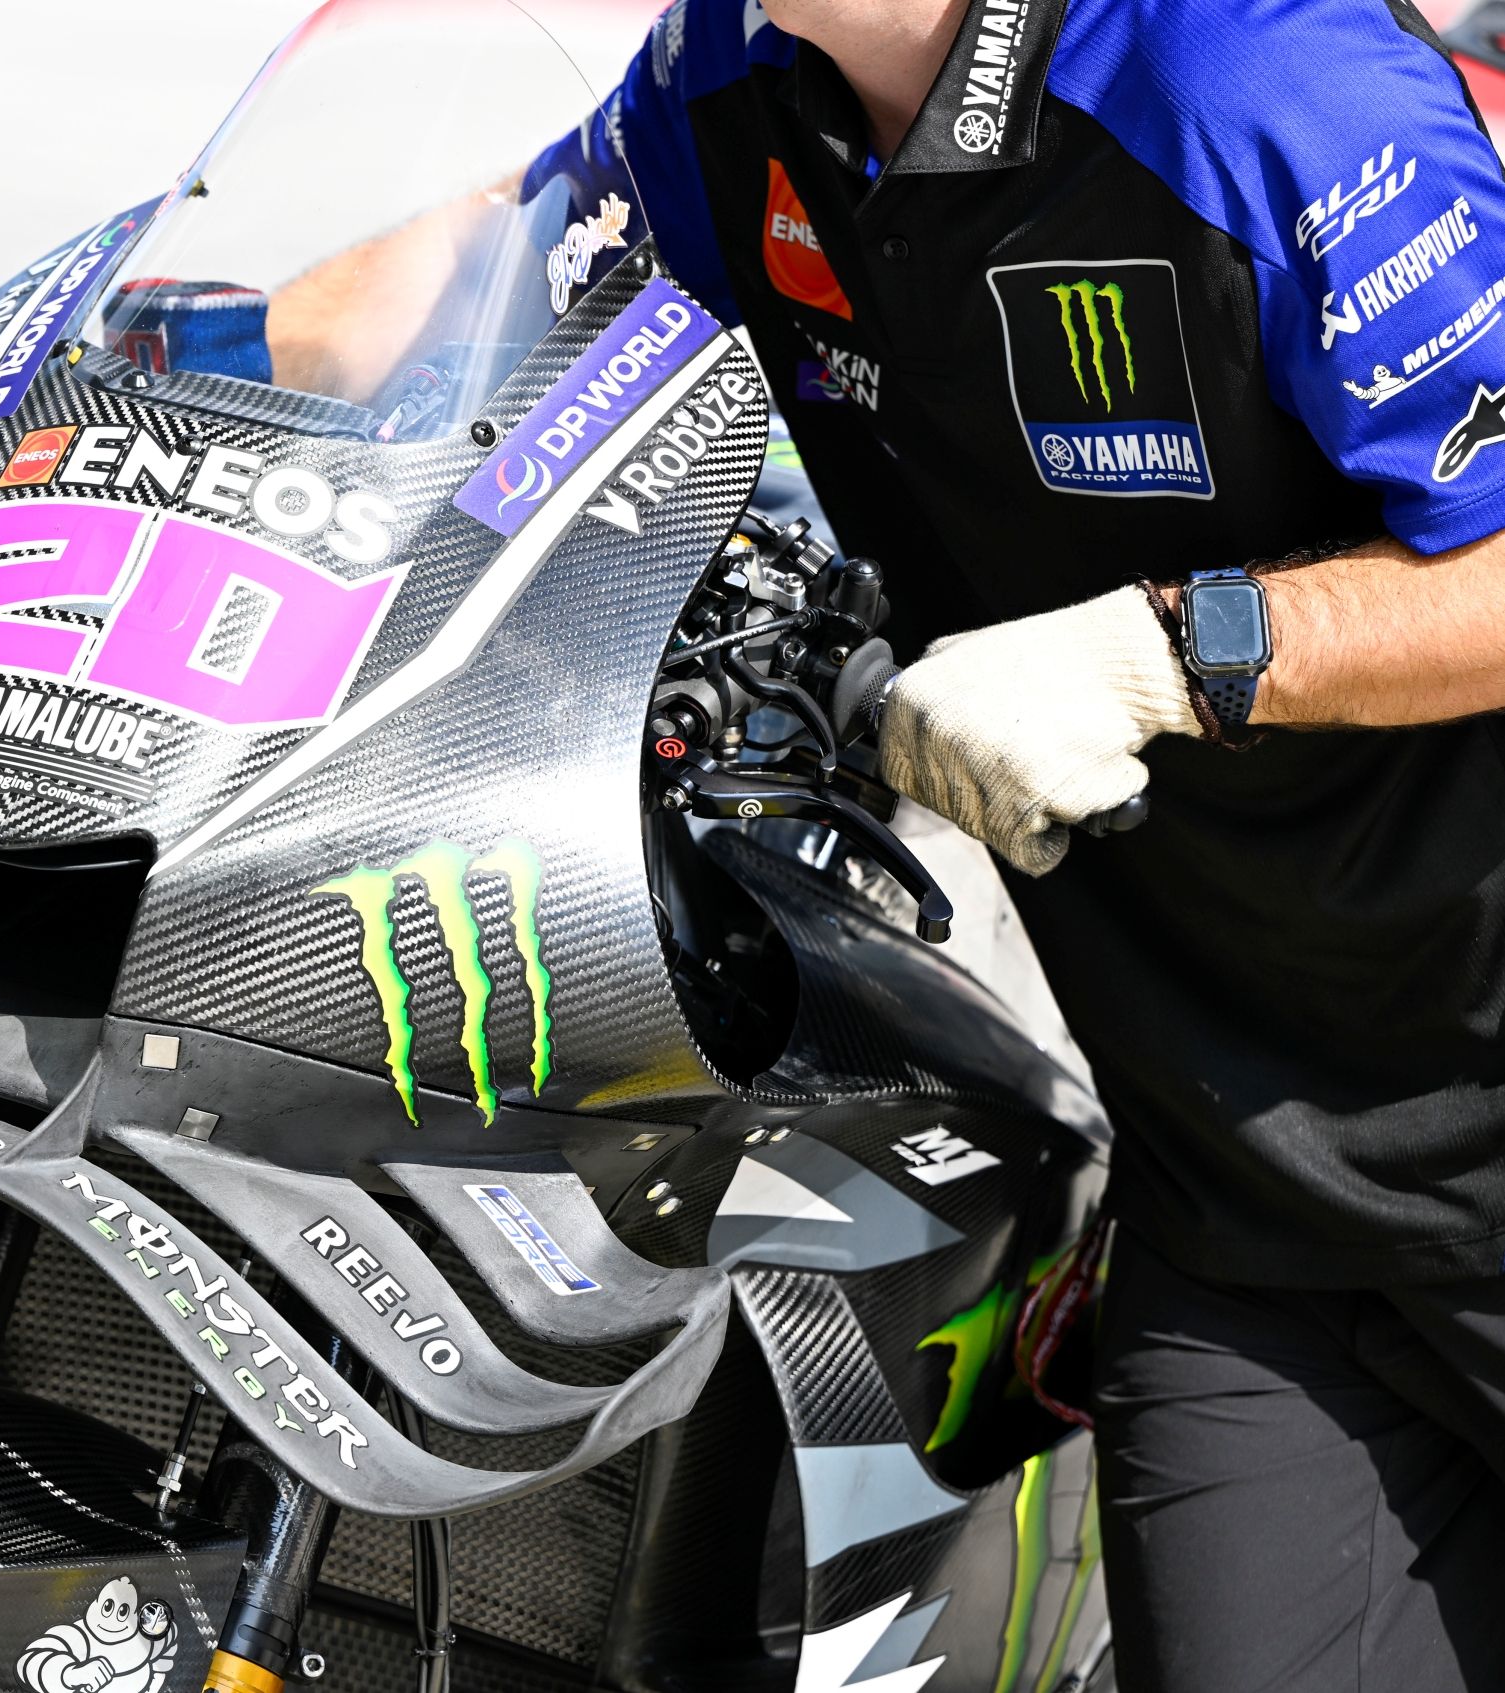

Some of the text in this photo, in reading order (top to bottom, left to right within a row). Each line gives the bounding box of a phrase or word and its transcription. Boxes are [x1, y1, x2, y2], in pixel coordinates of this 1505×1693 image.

[992, 0, 1031, 155] FACTORY RAC
[770, 212, 823, 254] ENE
[1295, 142, 1394, 249] BLU
[1311, 157, 1416, 262] CRU
[59, 254, 98, 294] DP
[536, 302, 692, 459] DP WORLD
[13, 448, 59, 464] ENEOS
[619, 372, 757, 503] Roboze
[1051, 470, 1202, 484] FACTORY RACING
[1071, 434, 1199, 473] YAMAHA
[57, 424, 396, 562] ENEOS
[37, 781, 124, 815] Component
[478, 1196, 558, 1284] CORE
[496, 1195, 584, 1283] BLUE
[60, 1171, 370, 1471] MONSTER
[86, 1217, 304, 1434] ENERGY
[301, 1216, 463, 1376] REEVO
